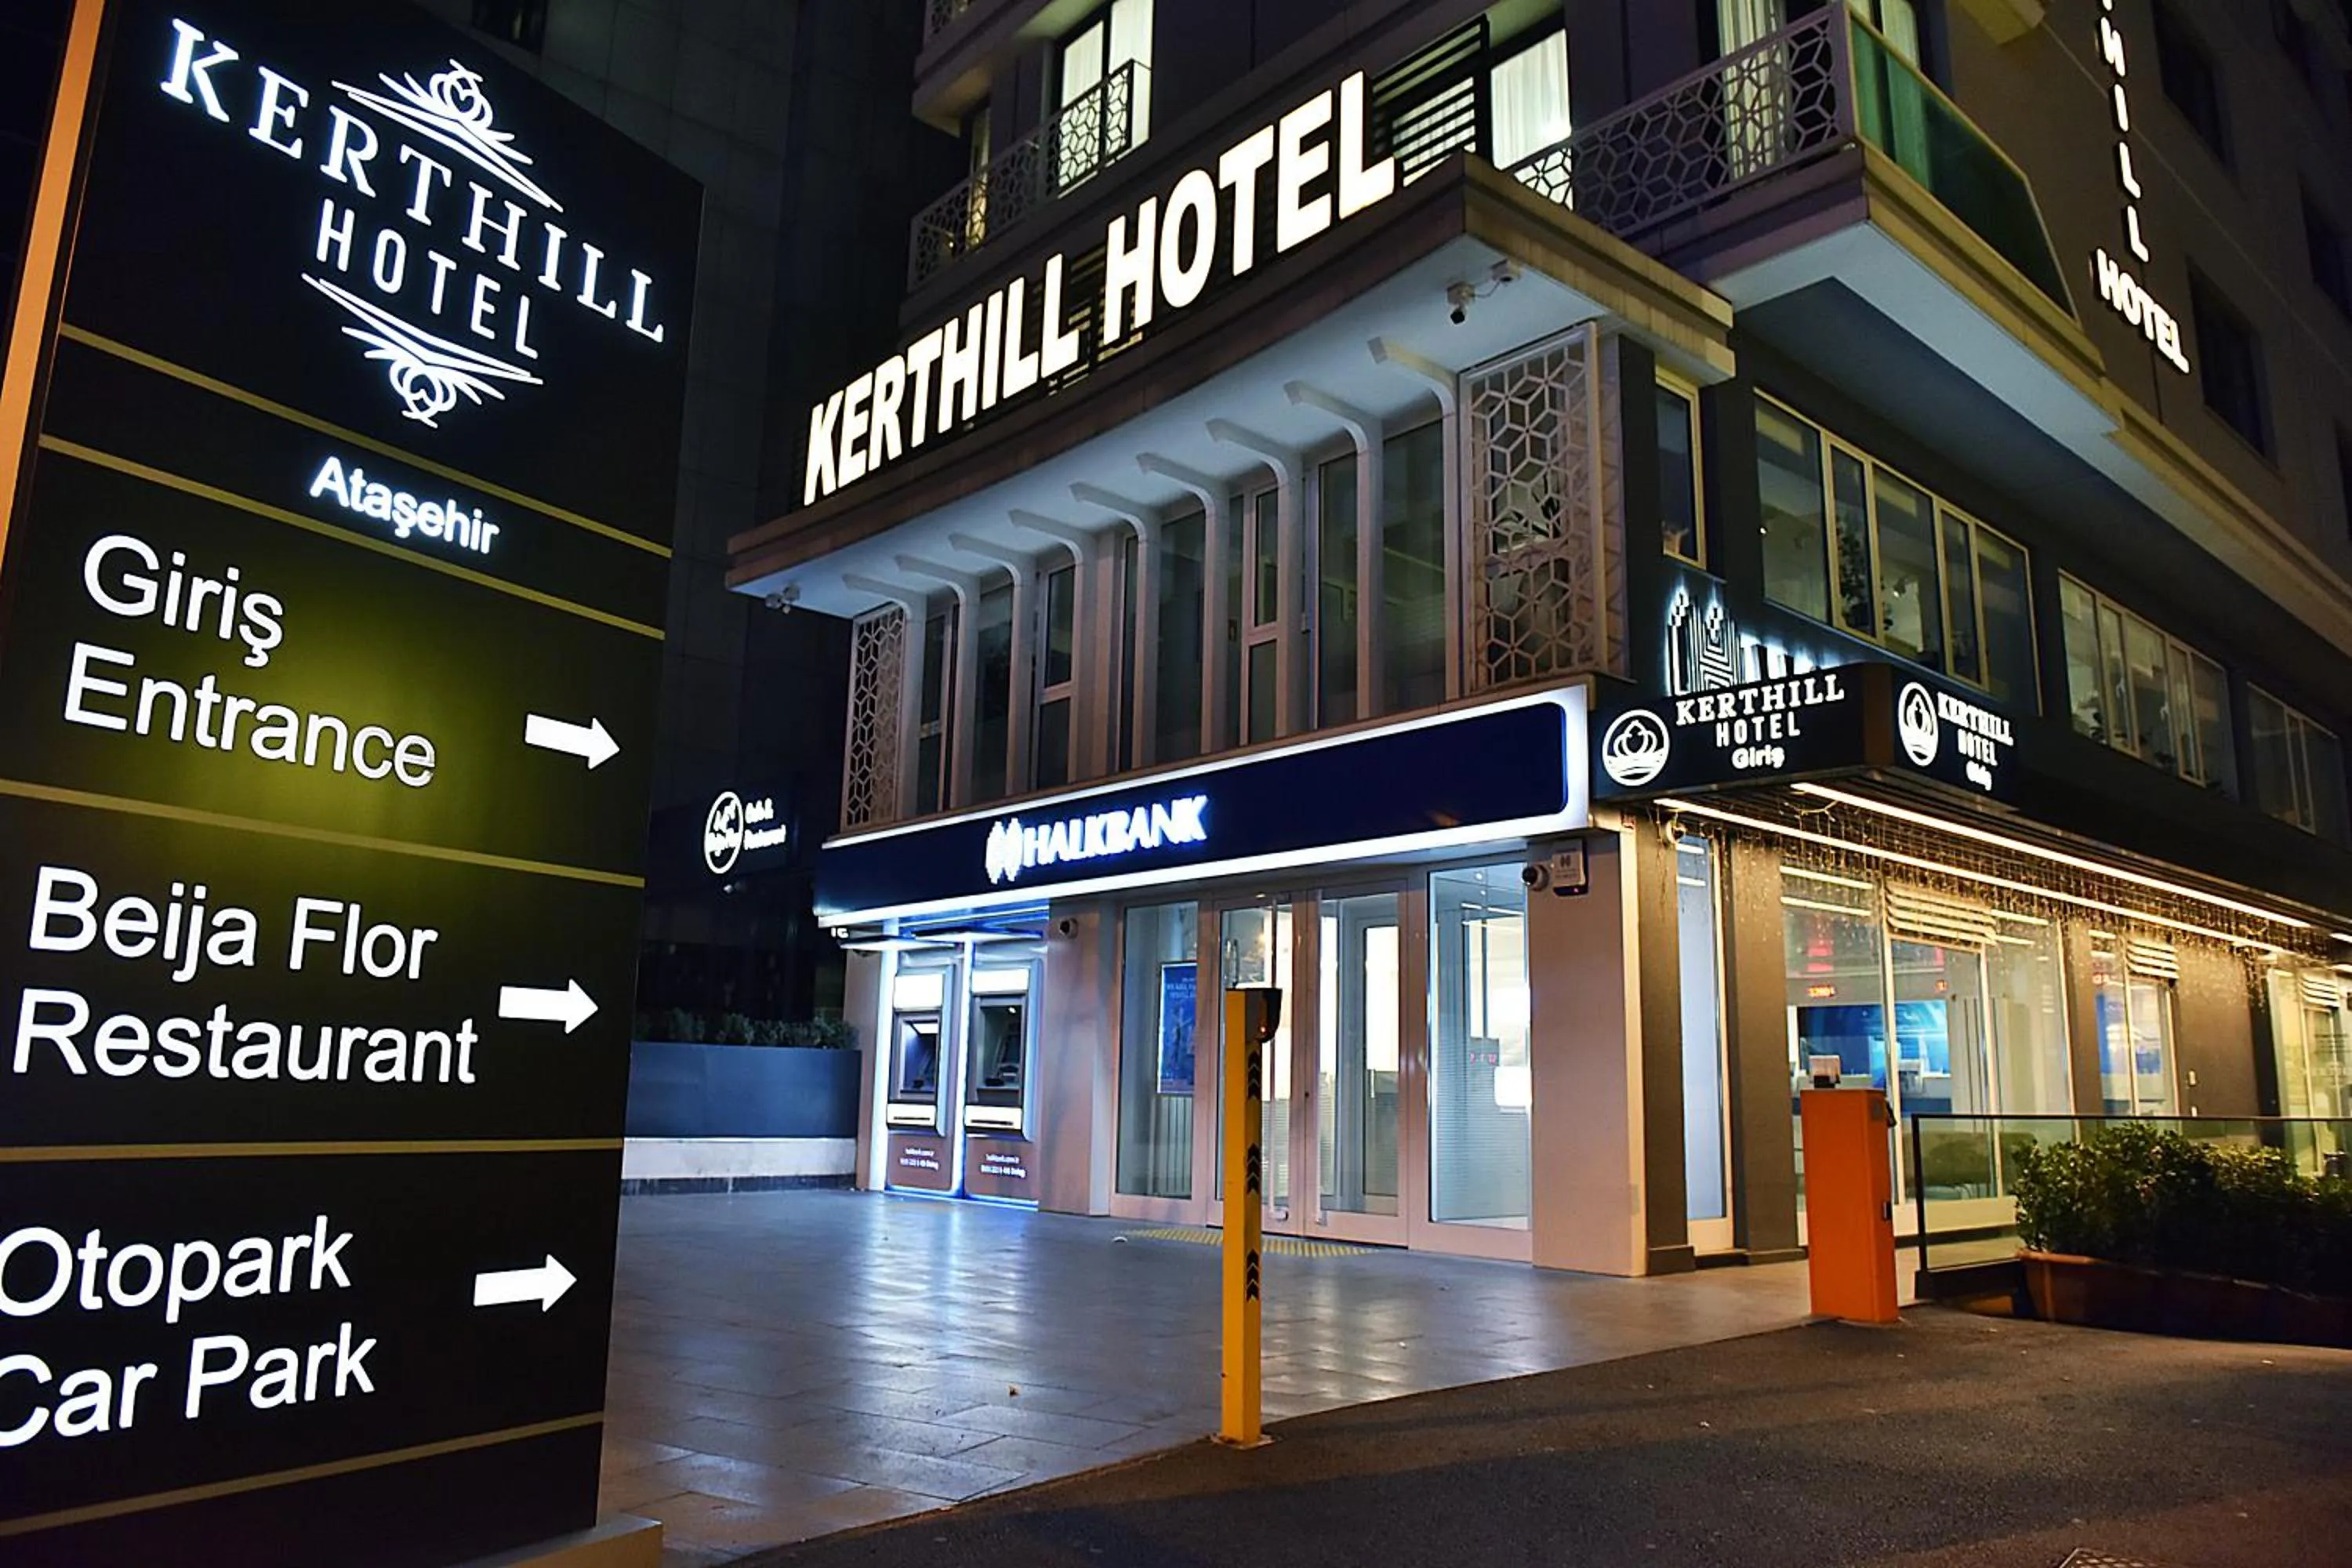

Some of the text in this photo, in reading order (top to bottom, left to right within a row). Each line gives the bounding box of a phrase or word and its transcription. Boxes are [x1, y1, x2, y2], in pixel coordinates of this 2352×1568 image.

[161, 18, 663, 343] KERTHILL
[2101, 0, 2148, 263] HILL
[316, 198, 538, 359] HOTEL
[804, 71, 1396, 506] KERTHILL HOTEL
[2097, 249, 2190, 373] HOTEL
[310, 456, 500, 554] Ataşehir
[83, 535, 284, 667] Giriş
[64, 641, 436, 786] Entrance
[1675, 674, 1845, 725] KERTHILL
[1715, 711, 1801, 747] HOTEL
[1937, 691, 2014, 746] KERTHILL
[1958, 728, 1998, 767] HOTEL
[1022, 794, 1208, 868] HALKBANK
[29, 866, 439, 982] Beija Flor
[13, 988, 478, 1083] Restaurant
[0, 1214, 354, 1323] Otopark
[0, 1322, 378, 1447] Car Park
